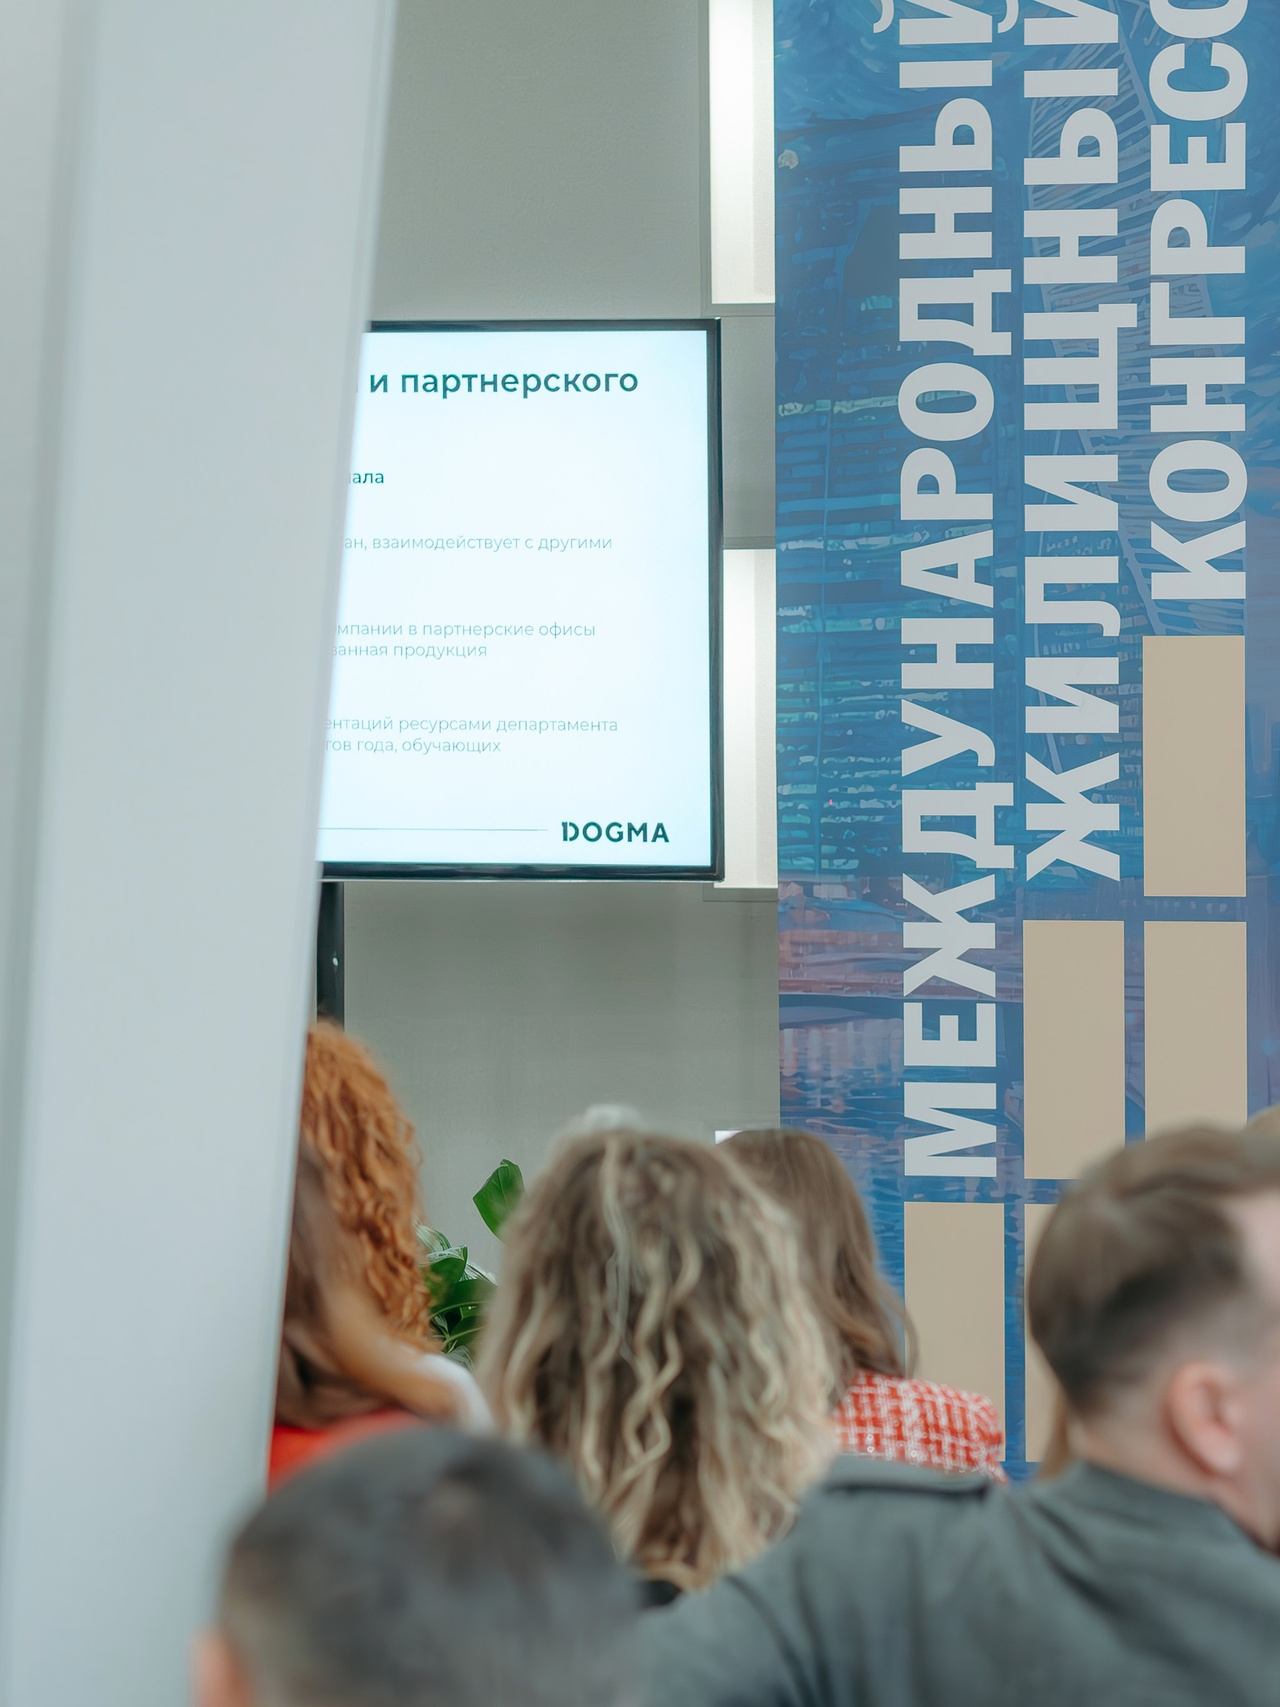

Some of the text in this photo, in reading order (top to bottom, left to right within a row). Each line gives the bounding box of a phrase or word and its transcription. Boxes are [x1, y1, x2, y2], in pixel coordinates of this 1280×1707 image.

[369, 372, 639, 400] и партнерского
[998, 0, 1137, 881] ЖИЛИЩНЫЙ
[372, 535, 521, 553] взаимодействует
[525, 538, 534, 550] с
[537, 538, 612, 553] другими
[873, 0, 1014, 1177] МЕЖДУНАРОДНЫЙ
[336, 621, 596, 640] мпании в партнерские офисы
[393, 645, 487, 660] продукция
[399, 719, 492, 734] ресурсами
[495, 720, 618, 735] департамента
[357, 740, 398, 754] года,
[401, 737, 501, 756] обучающих
[561, 821, 670, 843] DOGMA
